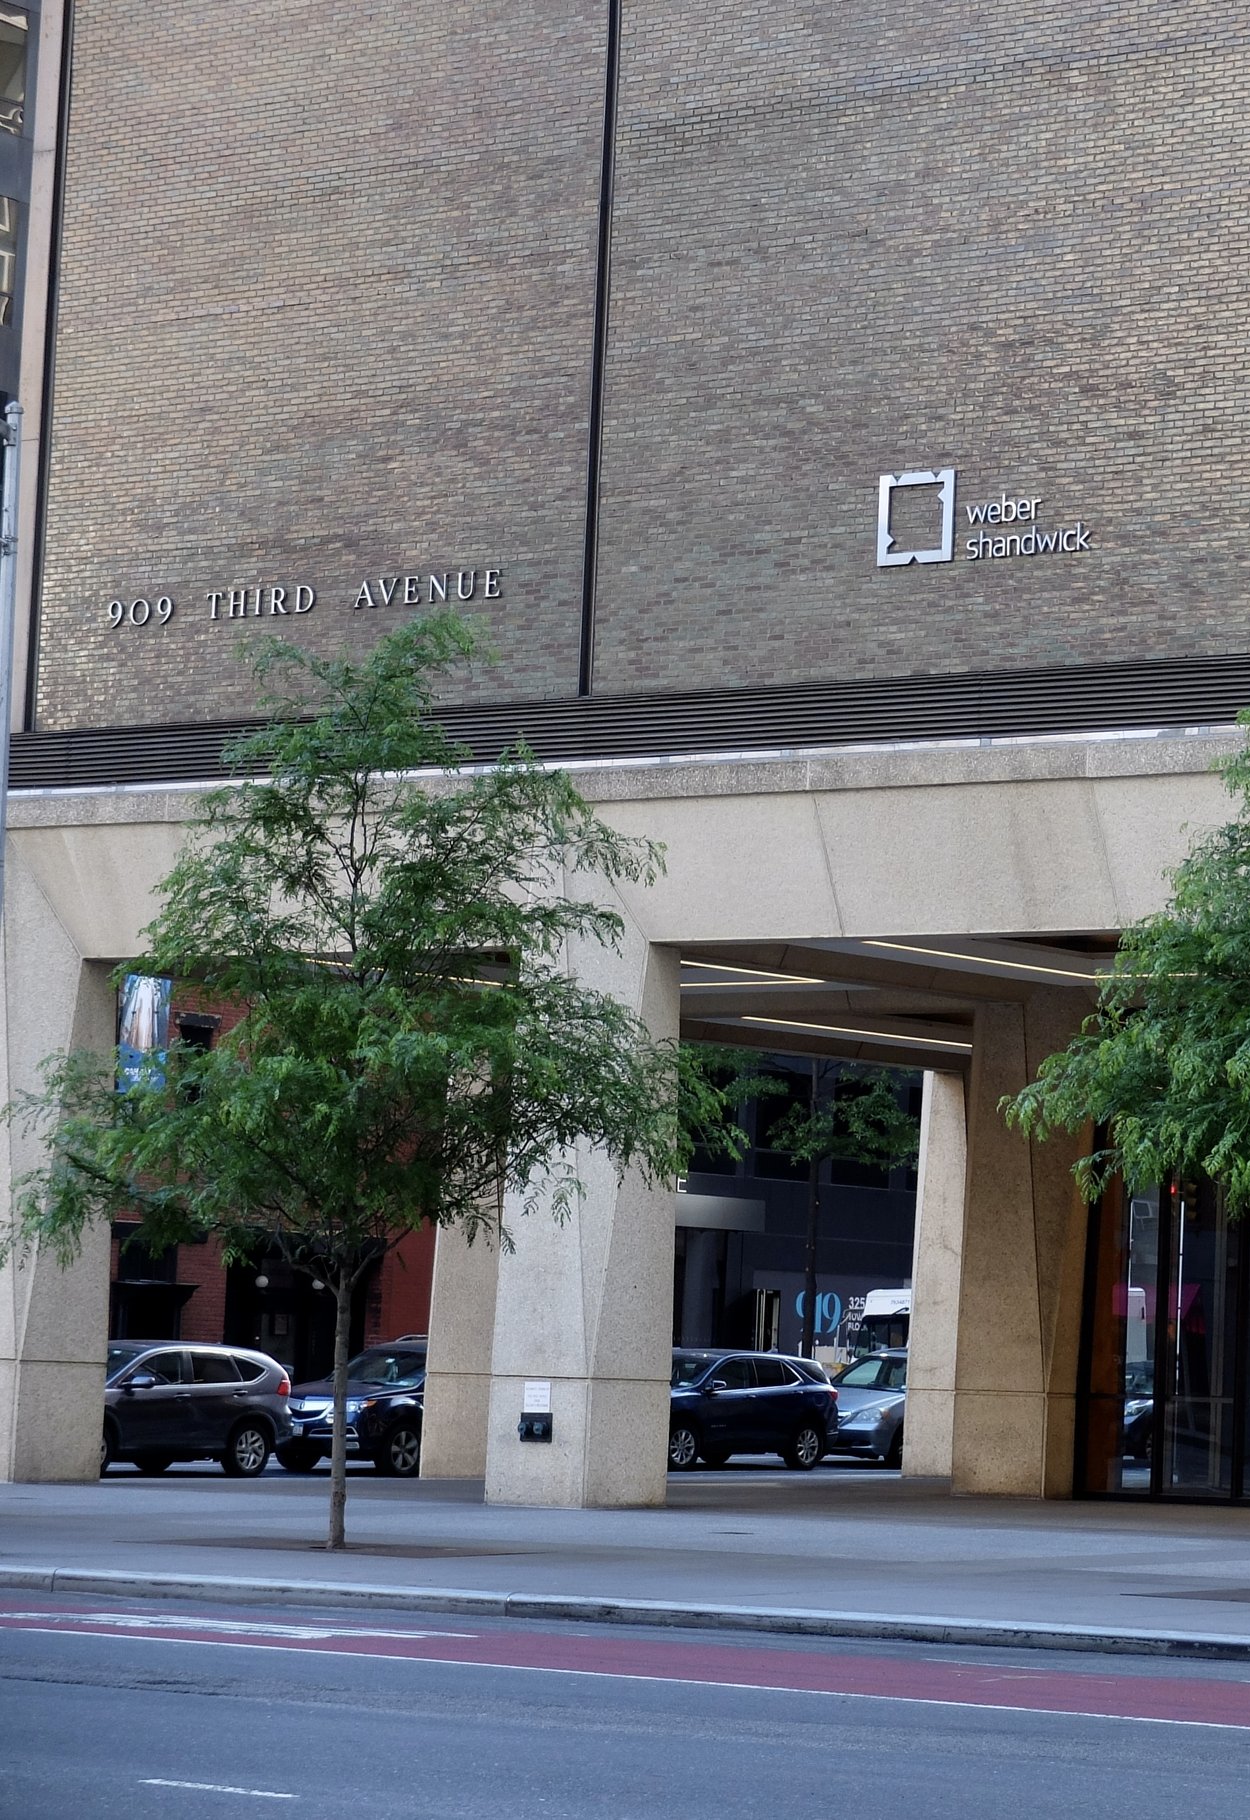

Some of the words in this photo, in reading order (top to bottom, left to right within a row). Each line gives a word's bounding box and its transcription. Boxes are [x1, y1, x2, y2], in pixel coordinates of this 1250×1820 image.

[966, 493, 1042, 525] weber
[966, 522, 1091, 560] shandwick
[108, 596, 174, 629] 909
[207, 585, 316, 620] THIRD
[354, 569, 501, 609] AVENUE
